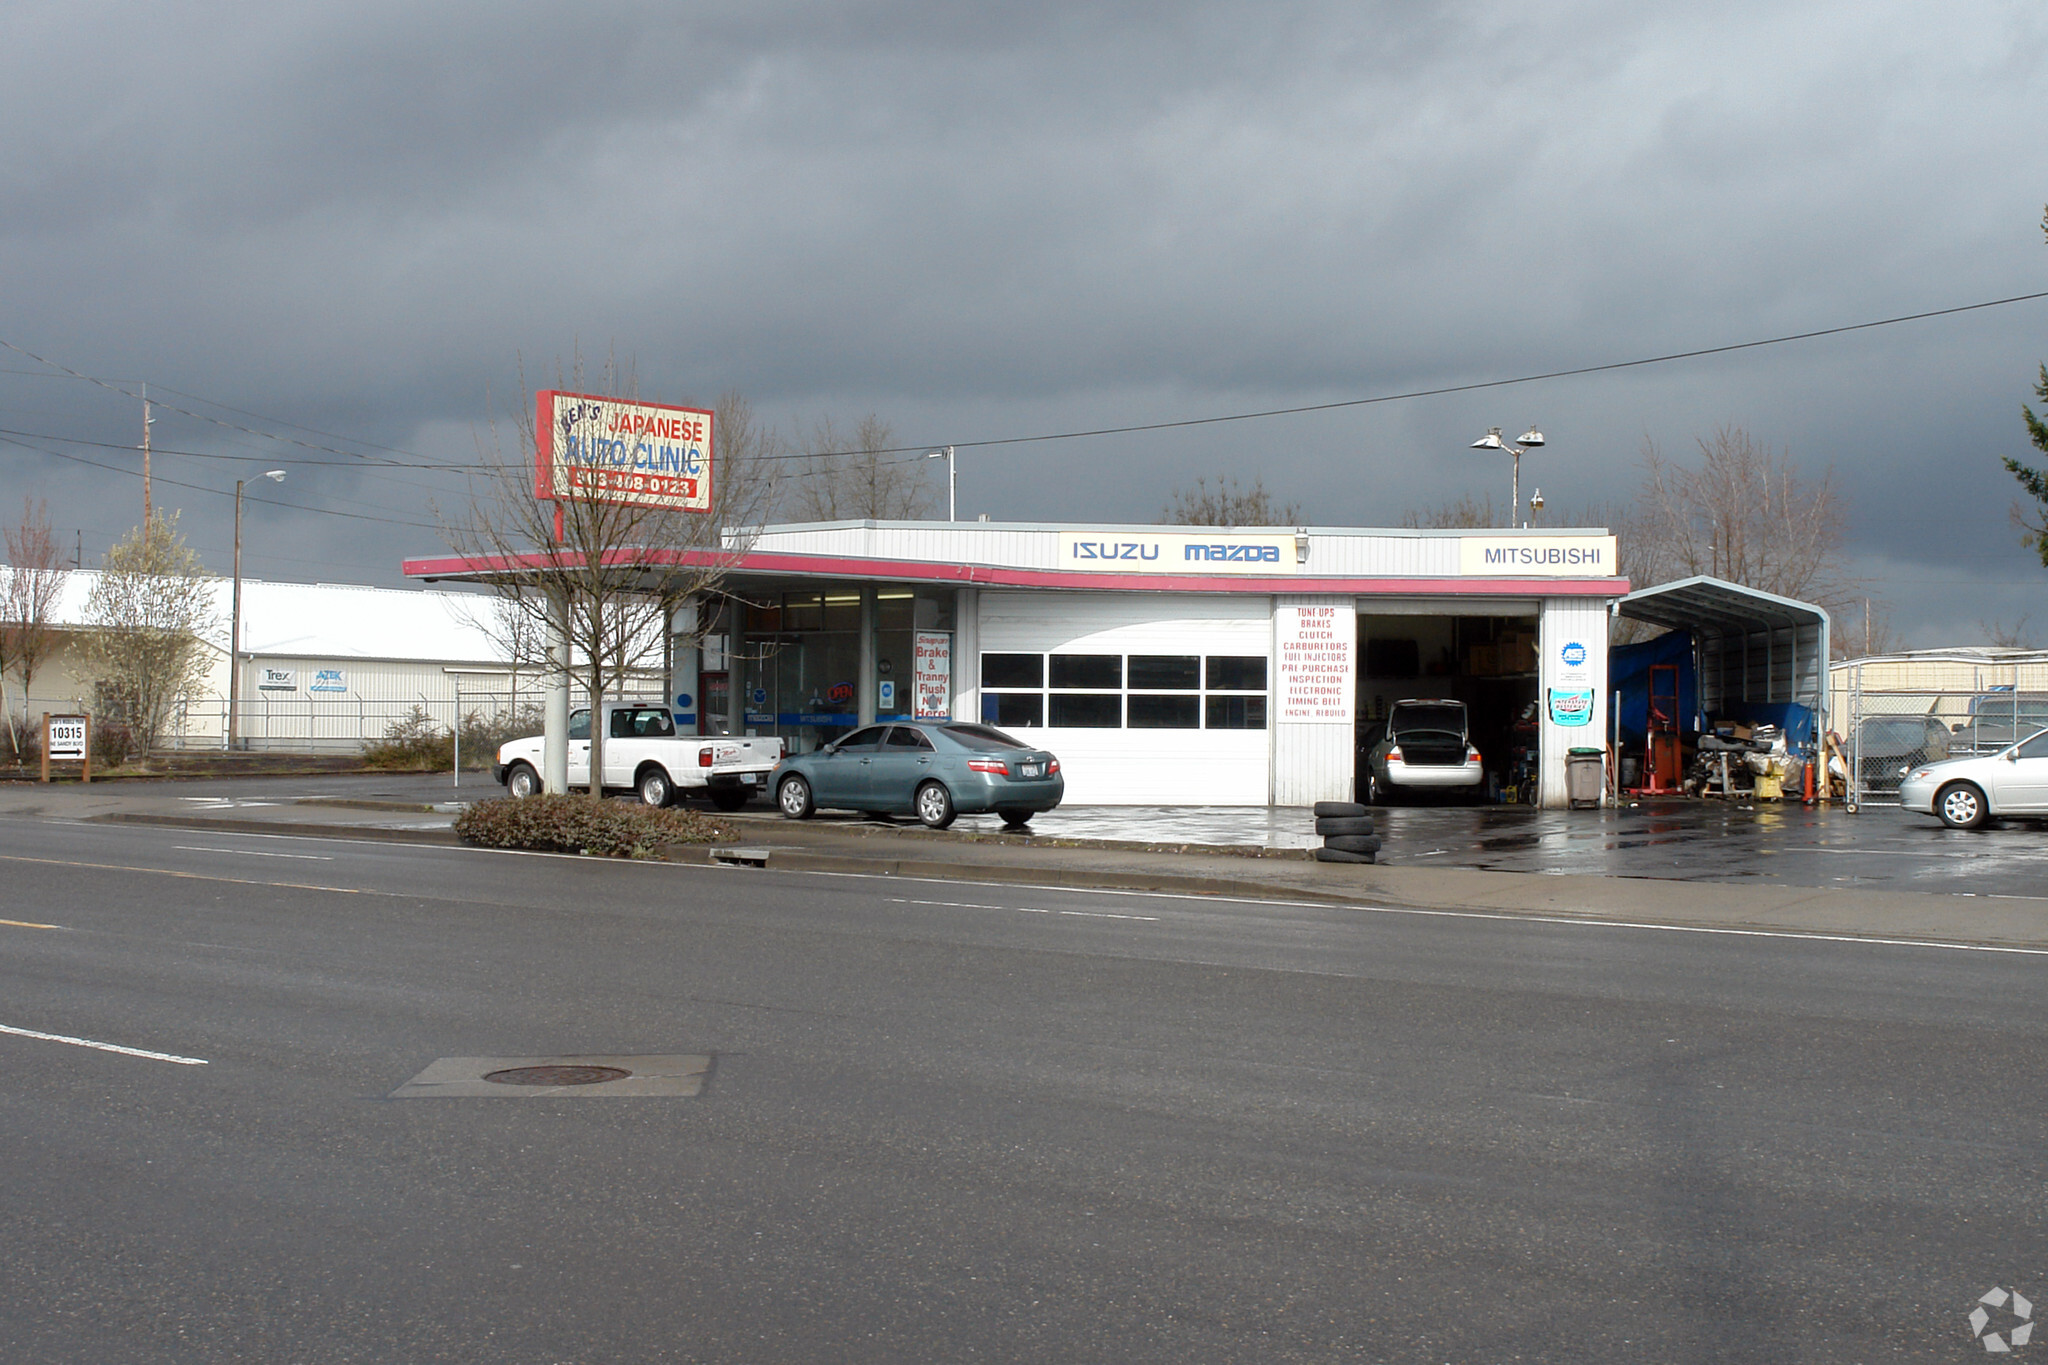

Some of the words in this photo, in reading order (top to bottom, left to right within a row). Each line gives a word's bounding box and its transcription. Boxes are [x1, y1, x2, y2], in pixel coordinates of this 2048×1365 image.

[608, 412, 703, 442] JAPANESE
[564, 435, 626, 466] AUTO
[634, 442, 701, 475] CLINIC
[1073, 542, 1159, 560] ISUZU
[1184, 544, 1280, 562] mazda
[1485, 548, 1600, 564] MITSUBISHI
[1297, 607, 1316, 617] TUNE
[1318, 608, 1335, 617] UPS
[1300, 619, 1331, 628] BRAKES
[1299, 631, 1333, 639] CLUTCH
[916, 646, 948, 657] Brake
[1283, 642, 1348, 651] CARBURETORS
[1284, 652, 1301, 661] FUEL
[1304, 652, 1347, 661] INJECTORS
[928, 659, 936, 670] &
[1302, 664, 1349, 673] PURCHASE
[266, 669, 290, 681] Trex
[915, 671, 949, 684] Tranny
[1289, 675, 1342, 683] INSPECTION
[827, 686, 853, 700] OPEN
[919, 683, 946, 694] Flush
[1289, 686, 1342, 695] ELECTRONIC
[922, 696, 943, 706] NW
[1287, 697, 1319, 706] TIMING
[1322, 697, 1341, 706] BELT
[1285, 709, 1310, 717] ENGINE
[1315, 709, 1346, 717] REBUILD
[52, 727, 82, 739] 10315
